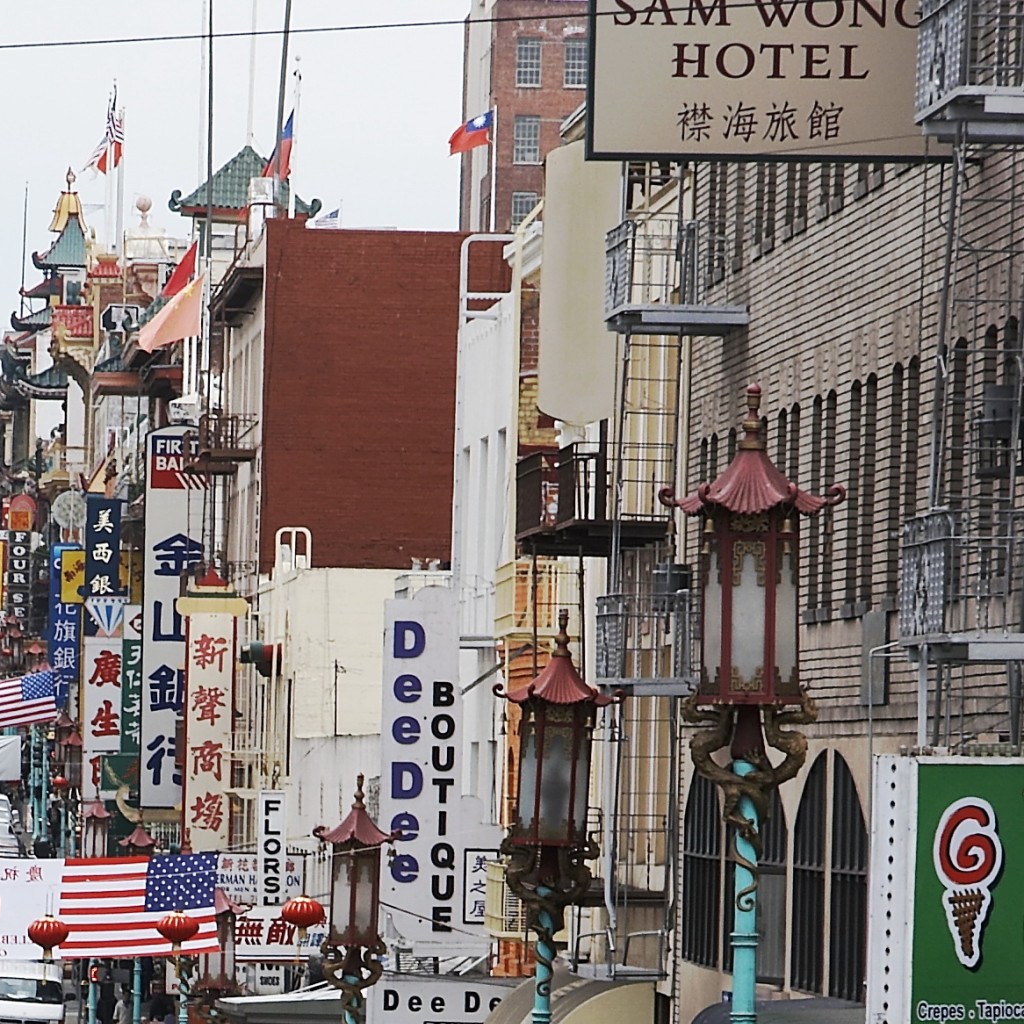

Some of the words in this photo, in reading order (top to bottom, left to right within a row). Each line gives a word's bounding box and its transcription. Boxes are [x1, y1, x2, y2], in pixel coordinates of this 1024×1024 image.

[613, 0, 730, 26] SAM
[761, 0, 923, 29] WONG
[671, 42, 870, 80] HOTEL
[156, 439, 199, 455] FIRT
[12, 532, 27, 584] FOUR
[89, 508, 115, 596] 美西銀
[430, 681, 456, 933] BOUTIQUE
[216, 873, 246, 885] ERMAN
[383, 988, 446, 1013] Dee
[464, 990, 503, 1013] De
[918, 1002, 964, 1023] Crepes
[978, 999, 1024, 1021] Tapioca
